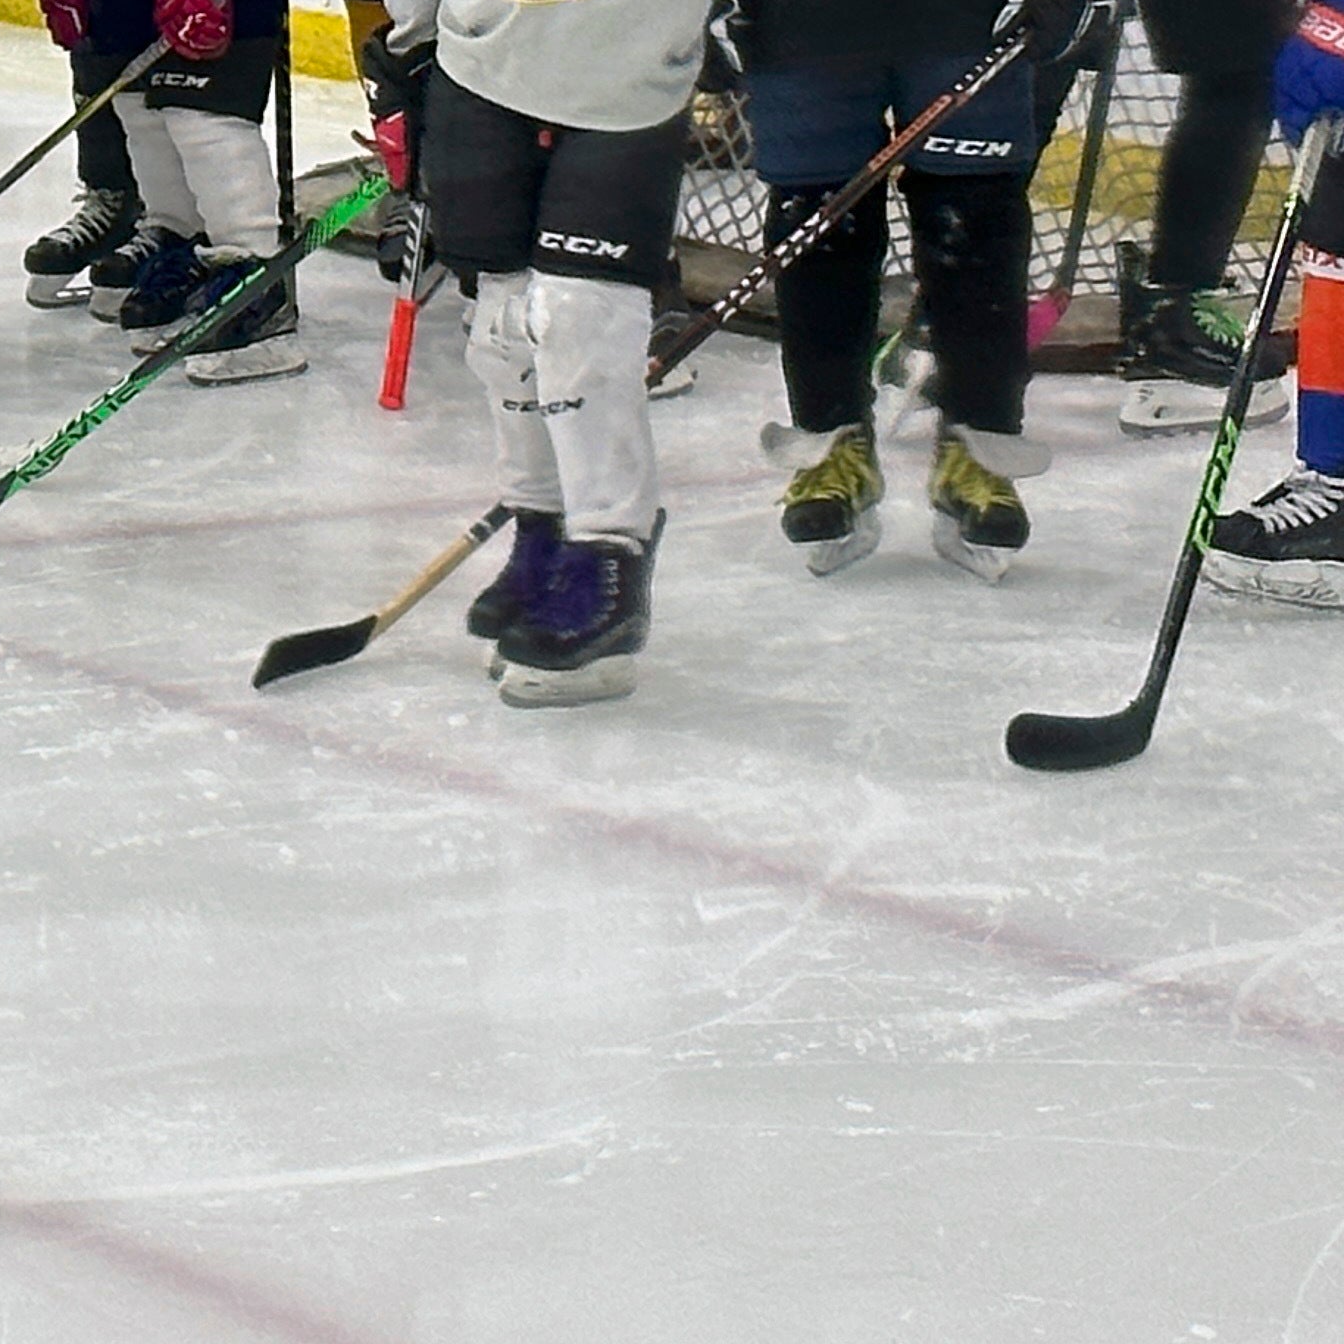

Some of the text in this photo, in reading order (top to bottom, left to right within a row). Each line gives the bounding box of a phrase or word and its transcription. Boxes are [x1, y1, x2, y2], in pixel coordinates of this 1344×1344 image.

[151, 72, 210, 88] CCM
[924, 136, 1013, 158] CCM
[538, 230, 630, 260] CCM
[1193, 415, 1238, 551] CCM
